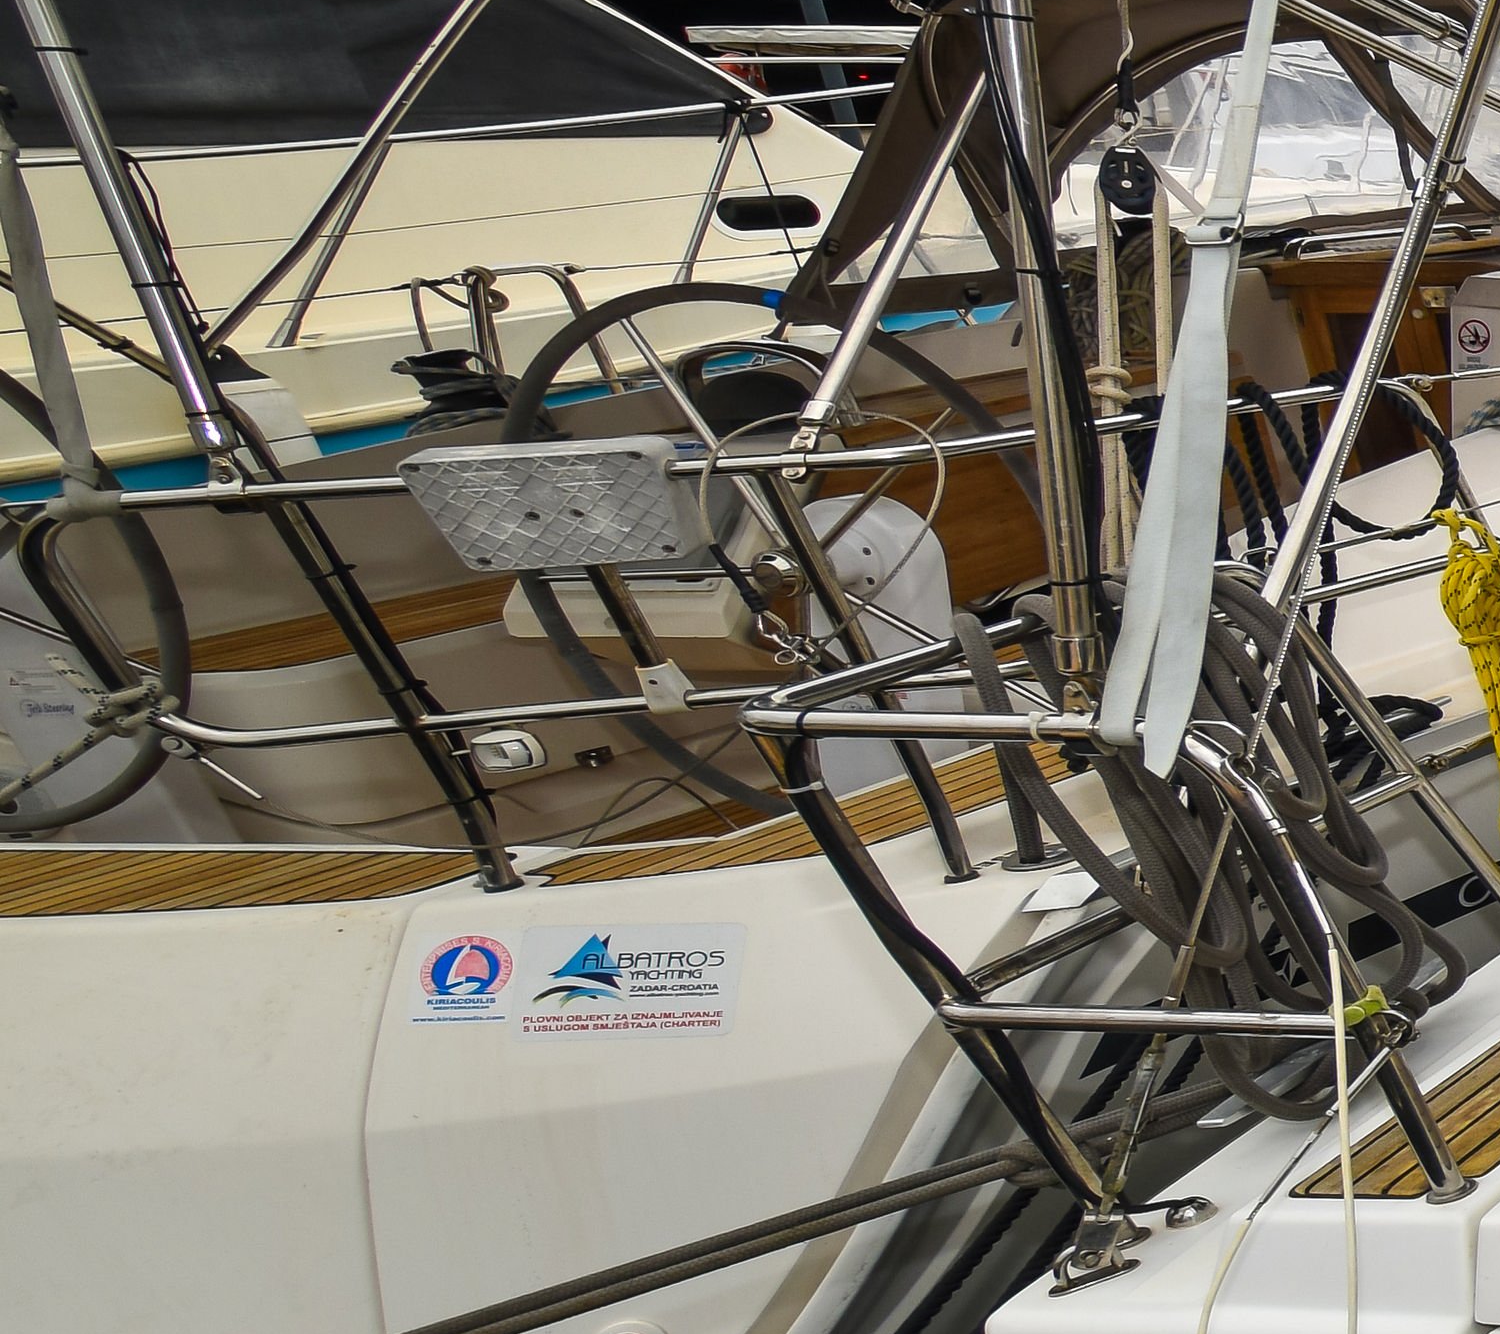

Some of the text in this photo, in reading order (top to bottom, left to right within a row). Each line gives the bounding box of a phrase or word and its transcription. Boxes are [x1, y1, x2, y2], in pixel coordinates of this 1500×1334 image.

[581, 951, 725, 969] ALBATROS
[629, 969, 703, 980] YACHTING
[629, 983, 719, 993] ZADAR-CROATIA
[427, 997, 496, 1005] KIRIACOULIS
[567, 1014, 611, 1022] OBJEKT
[631, 1010, 724, 1020] IZNAJMLJIVANJE
[534, 1024, 589, 1032] USLUGOM
[660, 1020, 721, 1029] (CHARTER)
